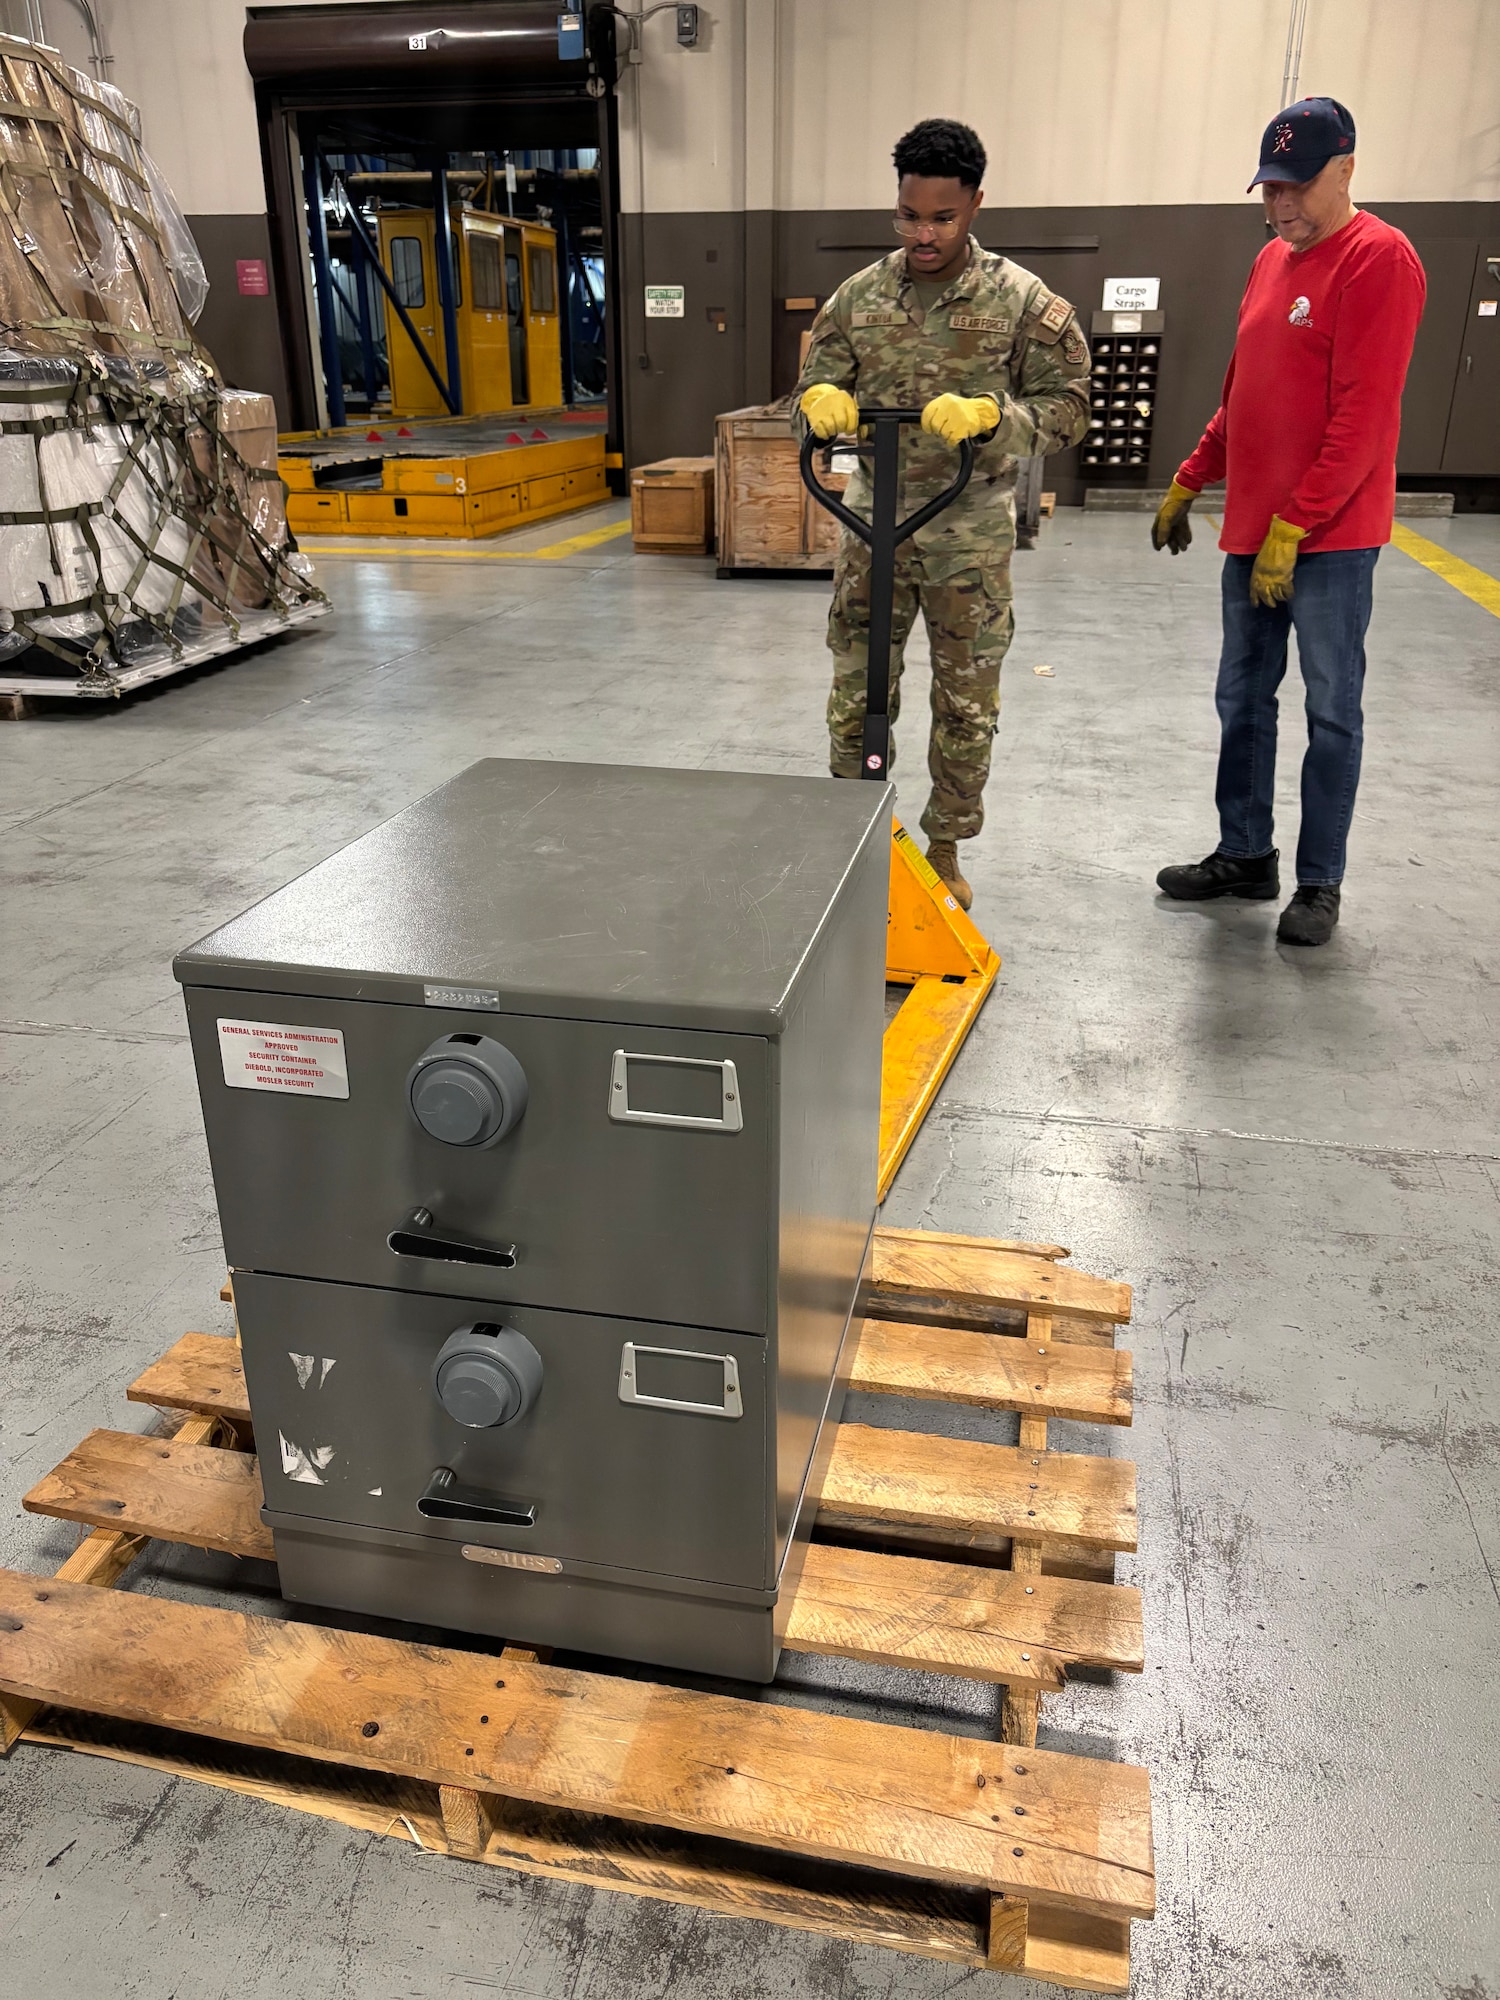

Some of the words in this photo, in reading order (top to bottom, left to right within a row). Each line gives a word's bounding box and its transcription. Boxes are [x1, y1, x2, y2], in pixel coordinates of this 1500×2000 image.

[412, 38, 424, 49] 31
[1116, 285, 1147, 297] Cargo
[1114, 298, 1146, 311] Straps
[968, 318, 980, 329] AIR
[981, 318, 1006, 331] FORCE
[455, 477, 467, 494] 3
[222, 1026, 251, 1036] GENERAL
[252, 1029, 283, 1039] SERVICES
[284, 1032, 338, 1044] ADMINISTRATION
[264, 1042, 299, 1052] APPROVED
[248, 1052, 279, 1061] SECURITY
[281, 1055, 317, 1065] CONTAINER
[245, 1063, 274, 1073] DIEBOLD,
[275, 1066, 324, 1078] INCORPORATED
[256, 1076, 283, 1085] MOSLER
[284, 1079, 315, 1088] SECURITY
